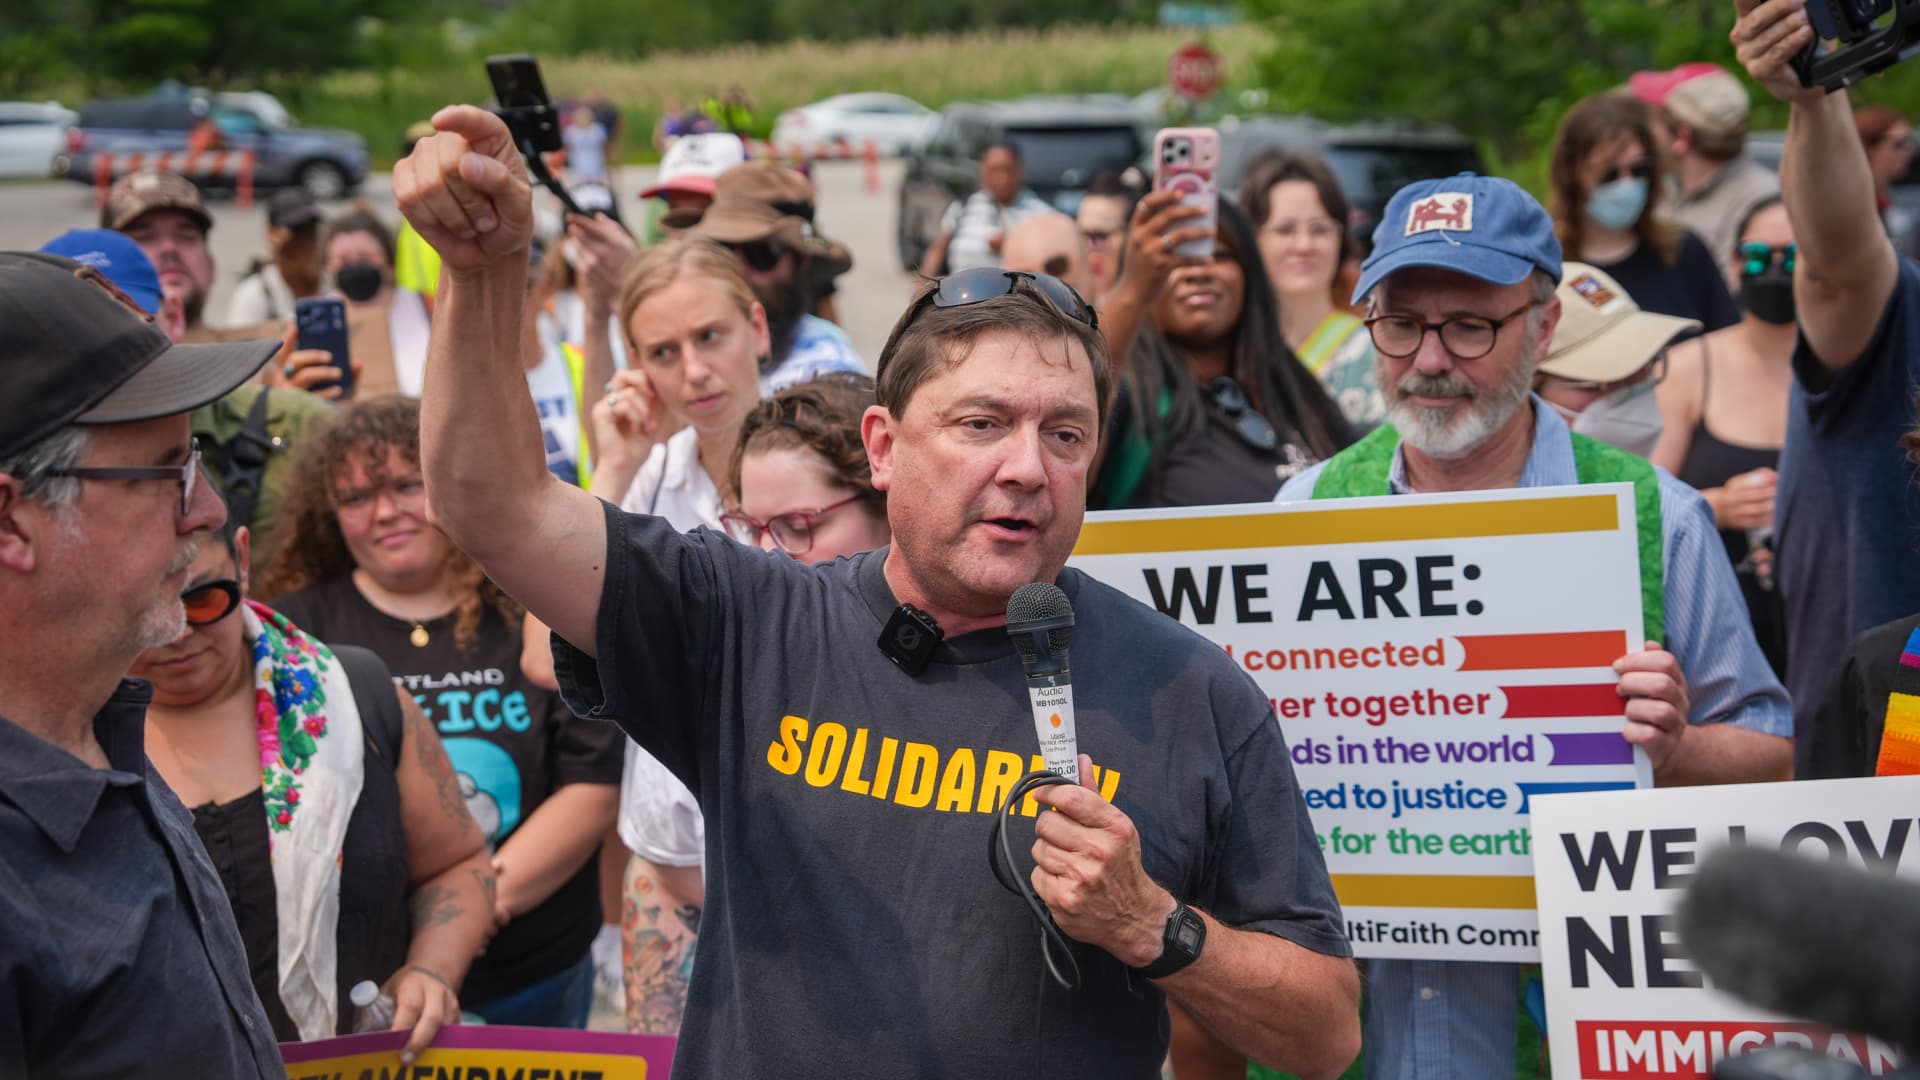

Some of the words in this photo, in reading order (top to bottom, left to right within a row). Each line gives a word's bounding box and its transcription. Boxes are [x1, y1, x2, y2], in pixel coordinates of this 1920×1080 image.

[1142, 563, 1273, 625] WE
[1296, 554, 1485, 622] ARE:
[1243, 638, 1446, 672] connected
[1037, 687, 1064, 697] Audio
[1324, 688, 1491, 727] together
[1336, 735, 1369, 764] in
[1373, 736, 1431, 764] the
[1435, 734, 1536, 763] world
[1352, 784, 1388, 809] to
[1391, 780, 1508, 819] justice
[1330, 826, 1377, 855] for
[1386, 827, 1444, 855] the
[1559, 827, 1697, 893] WE
